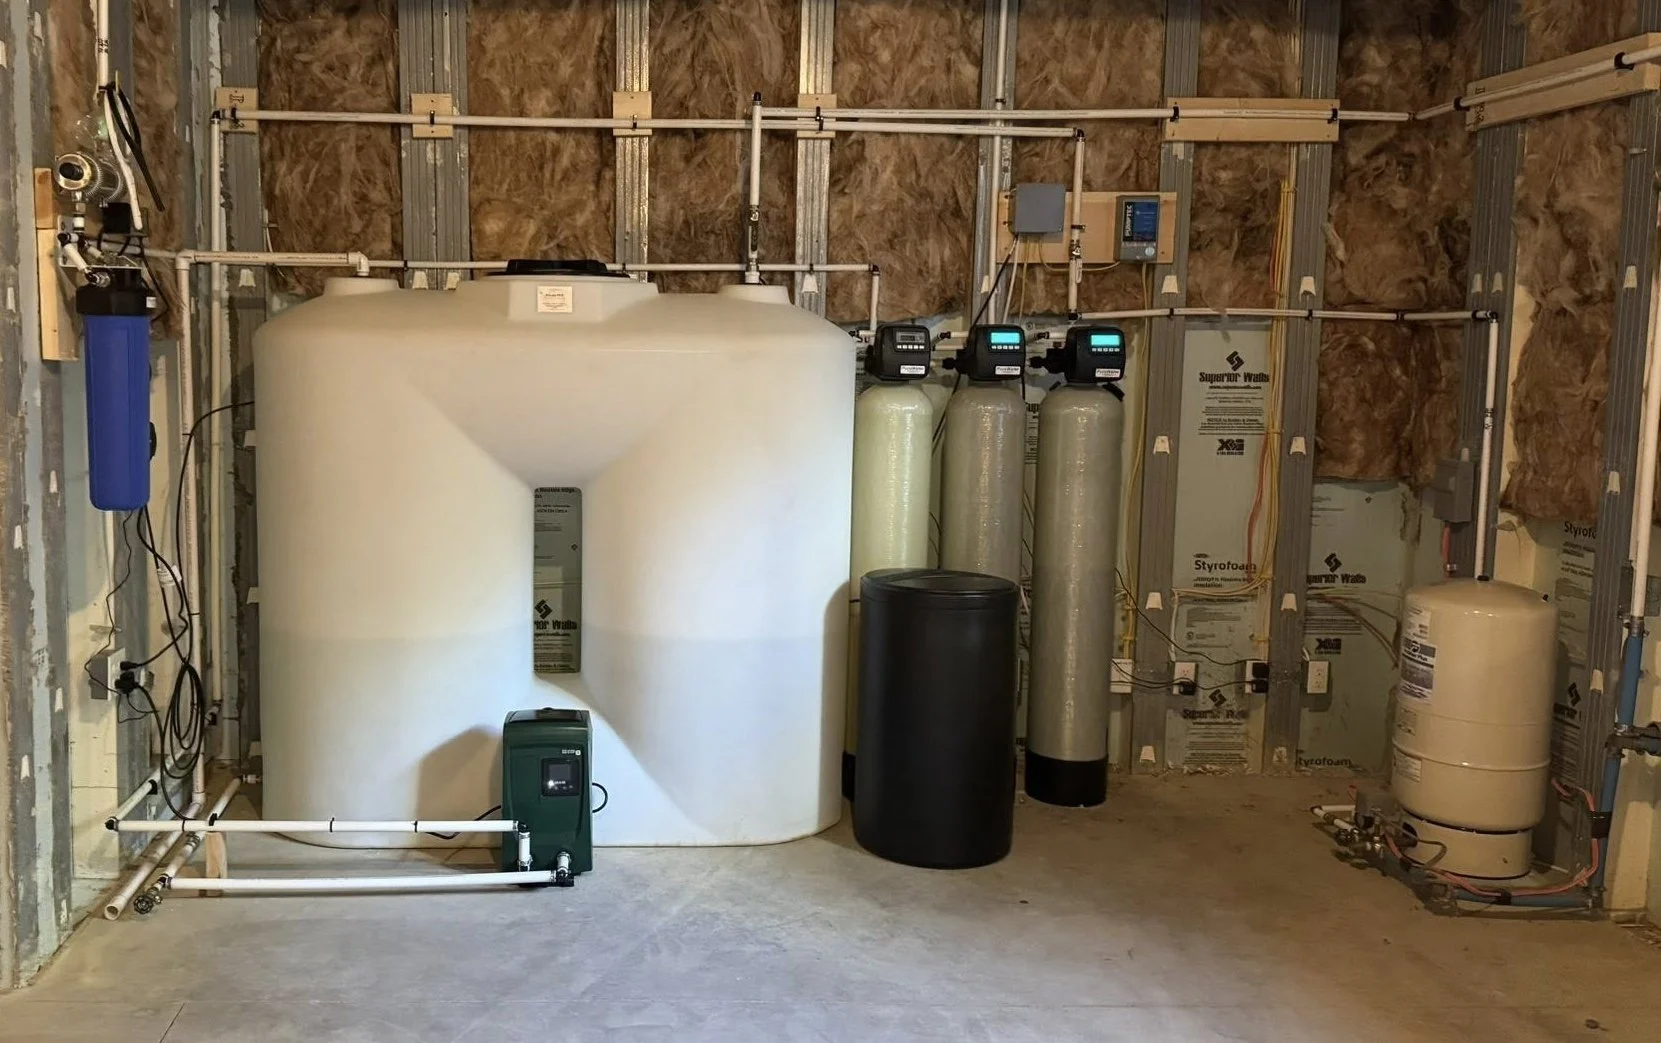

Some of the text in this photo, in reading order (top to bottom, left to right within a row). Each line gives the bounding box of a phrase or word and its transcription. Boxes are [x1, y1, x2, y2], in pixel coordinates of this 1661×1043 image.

[1199, 372, 1270, 384] Superior Walls
[1194, 560, 1257, 573] Styrofoam
